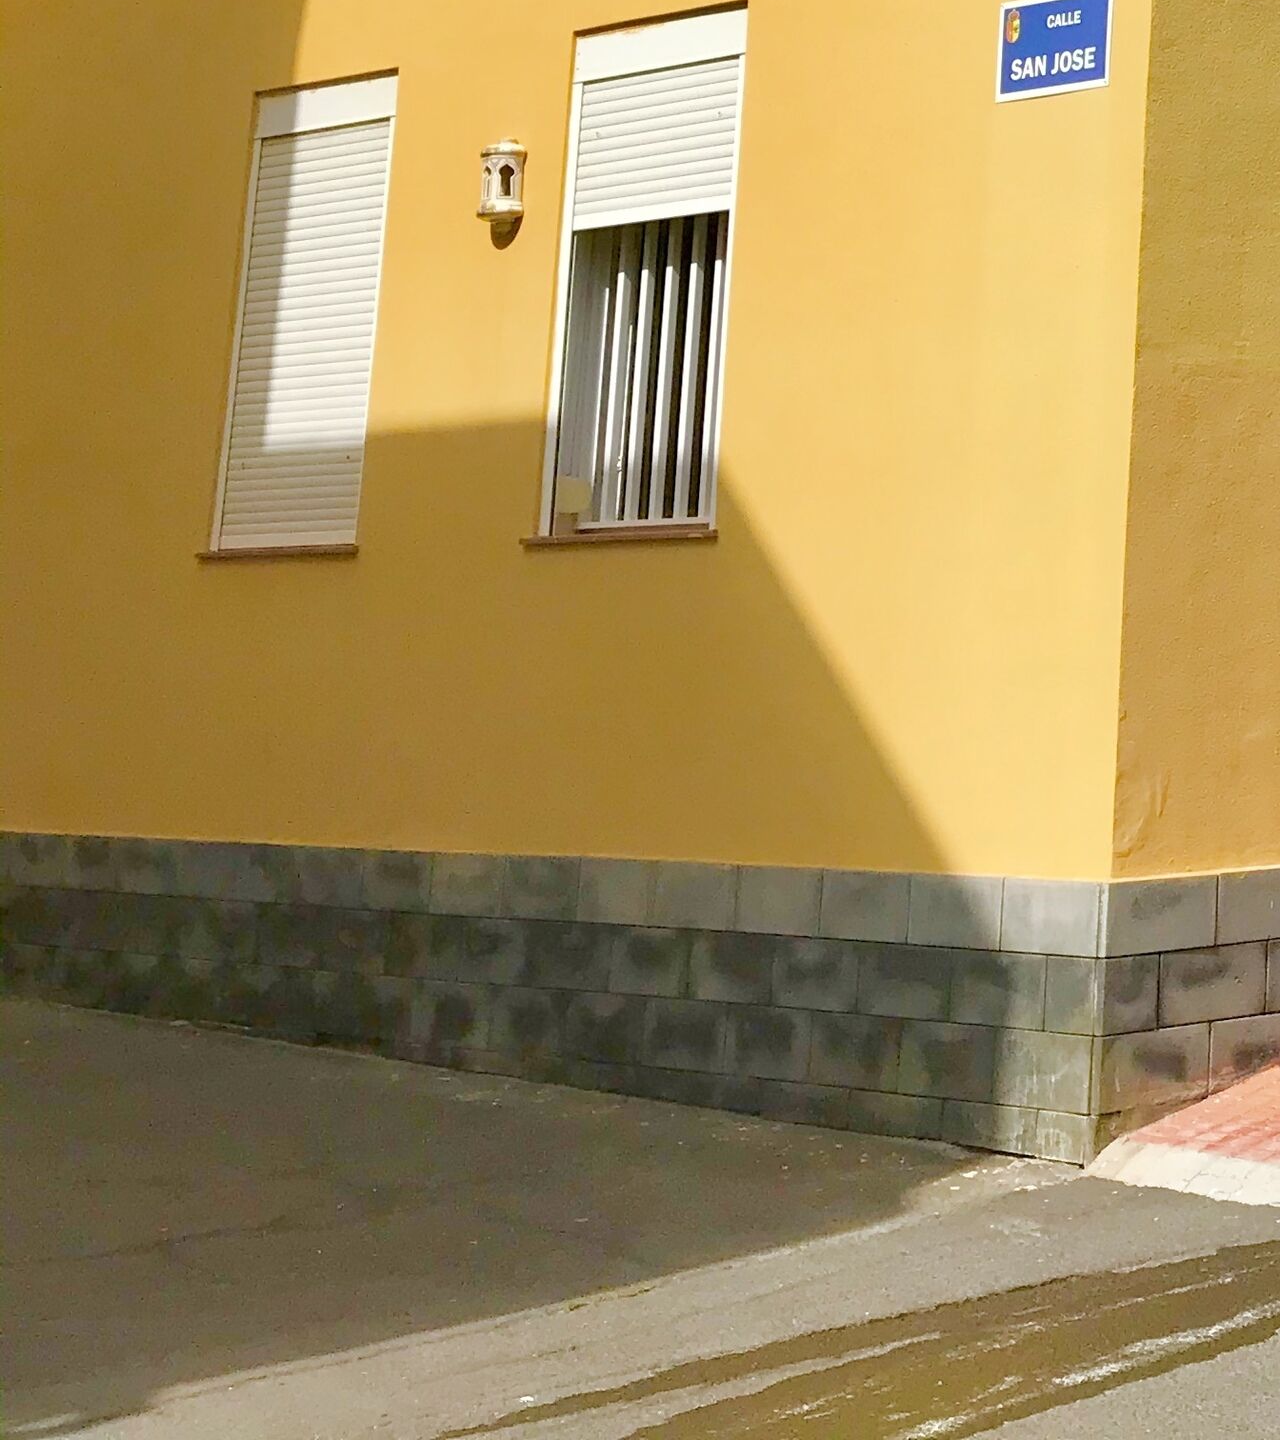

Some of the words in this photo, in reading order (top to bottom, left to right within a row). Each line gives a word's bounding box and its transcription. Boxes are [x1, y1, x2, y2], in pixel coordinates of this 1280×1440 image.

[1046, 9, 1081, 29] CALLE
[1010, 54, 1047, 80] SAN
[1050, 46, 1096, 75] JOSE
